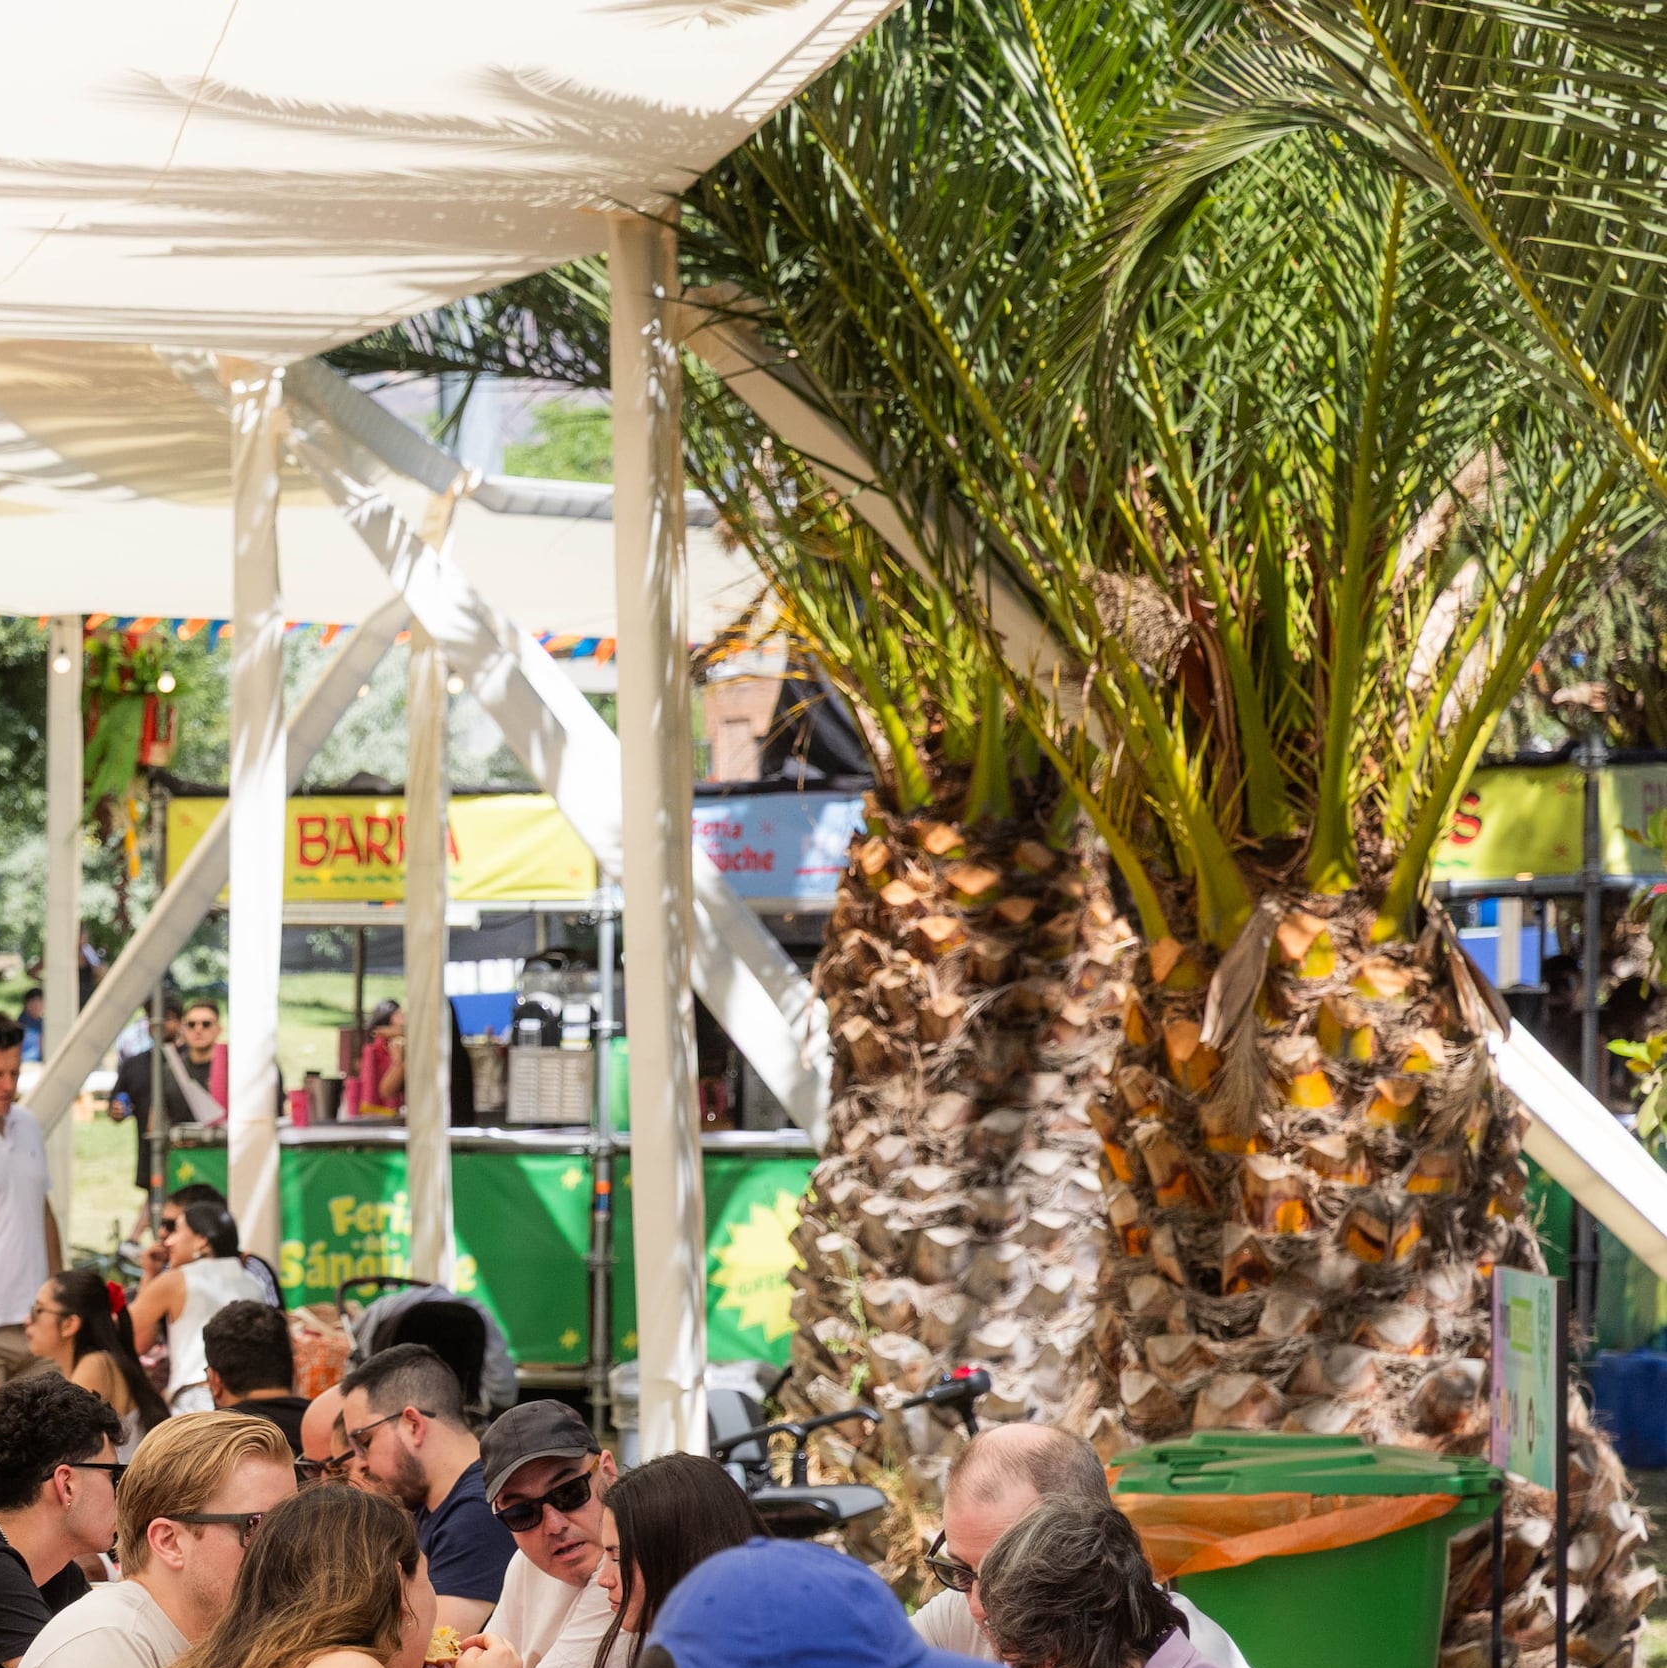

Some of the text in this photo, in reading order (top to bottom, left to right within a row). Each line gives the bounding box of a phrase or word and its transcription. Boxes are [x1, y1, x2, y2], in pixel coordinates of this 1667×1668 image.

[297, 815, 460, 867] BAR
[328, 1191, 412, 1236] Feri
[280, 1240, 478, 1297] Sángue
